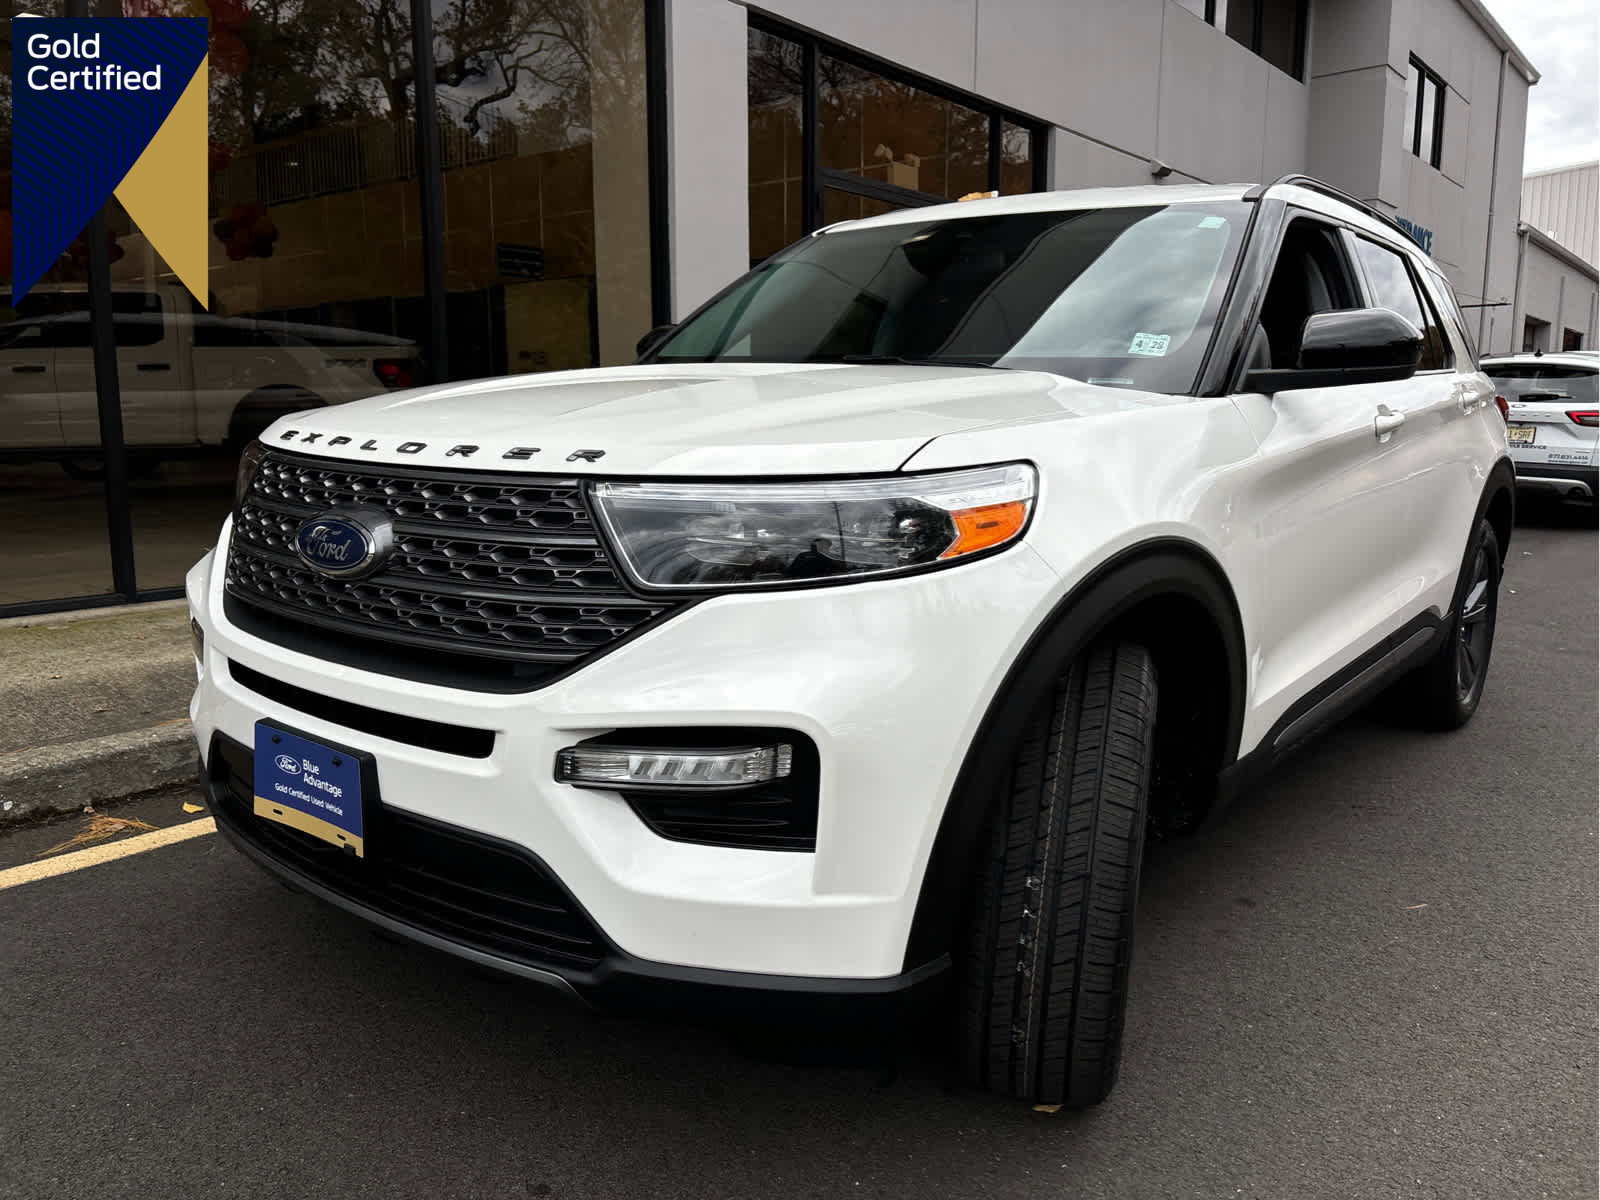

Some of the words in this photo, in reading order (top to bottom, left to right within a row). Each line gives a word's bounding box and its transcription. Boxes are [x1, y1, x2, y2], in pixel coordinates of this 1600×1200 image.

[279, 430, 607, 463] EXPLORER
[303, 525, 352, 562] Ford
[280, 757, 297, 772] Ford
[302, 759, 320, 775] Blue
[274, 782, 288, 794] Gold
[288, 787, 311, 802] Certified
[310, 795, 324, 808] Used
[325, 801, 343, 816] Vehicle
[303, 772, 343, 798] Advantage
